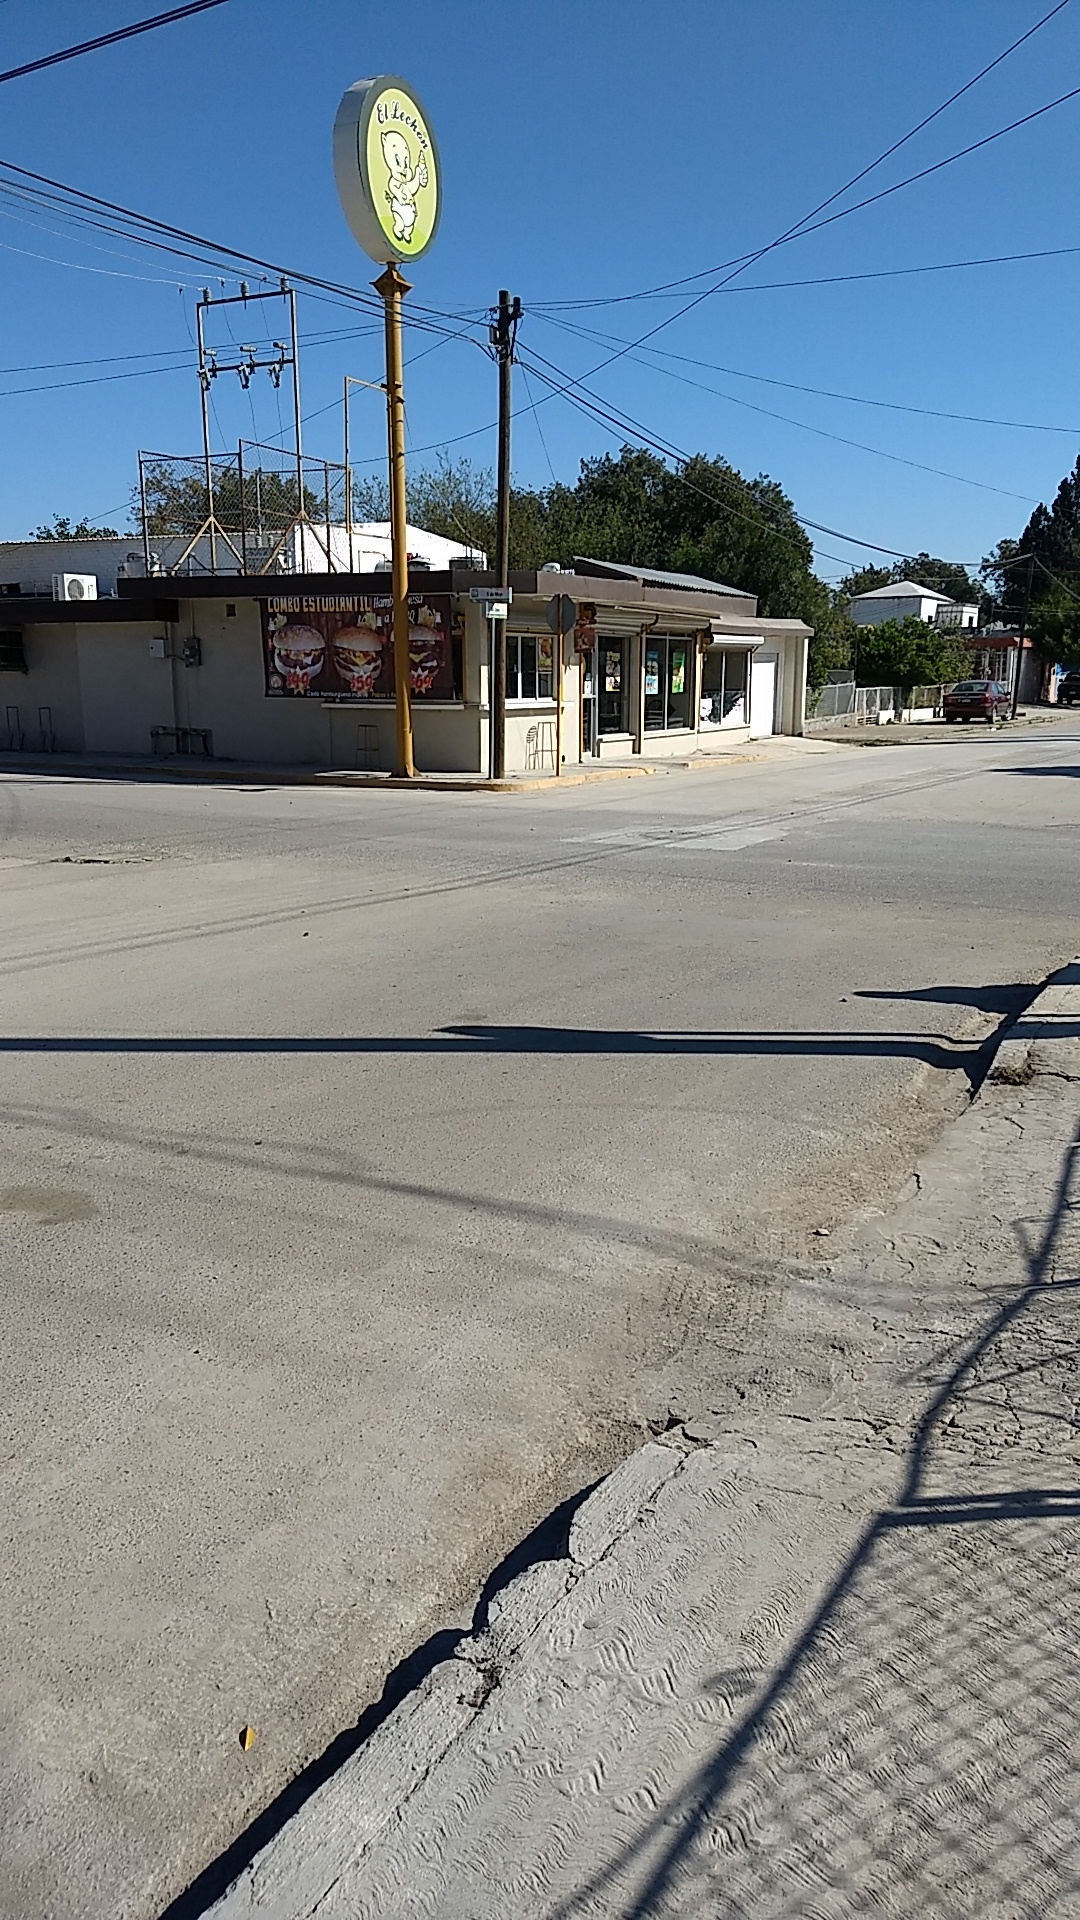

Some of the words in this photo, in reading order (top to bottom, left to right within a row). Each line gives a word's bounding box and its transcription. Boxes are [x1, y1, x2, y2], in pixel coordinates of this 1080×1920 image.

[376, 103, 389, 124] El
[267, 597, 300, 613] COMBO
[302, 595, 371, 613] ESTUDIANTIL
[373, 595, 423, 609] Hambesa
